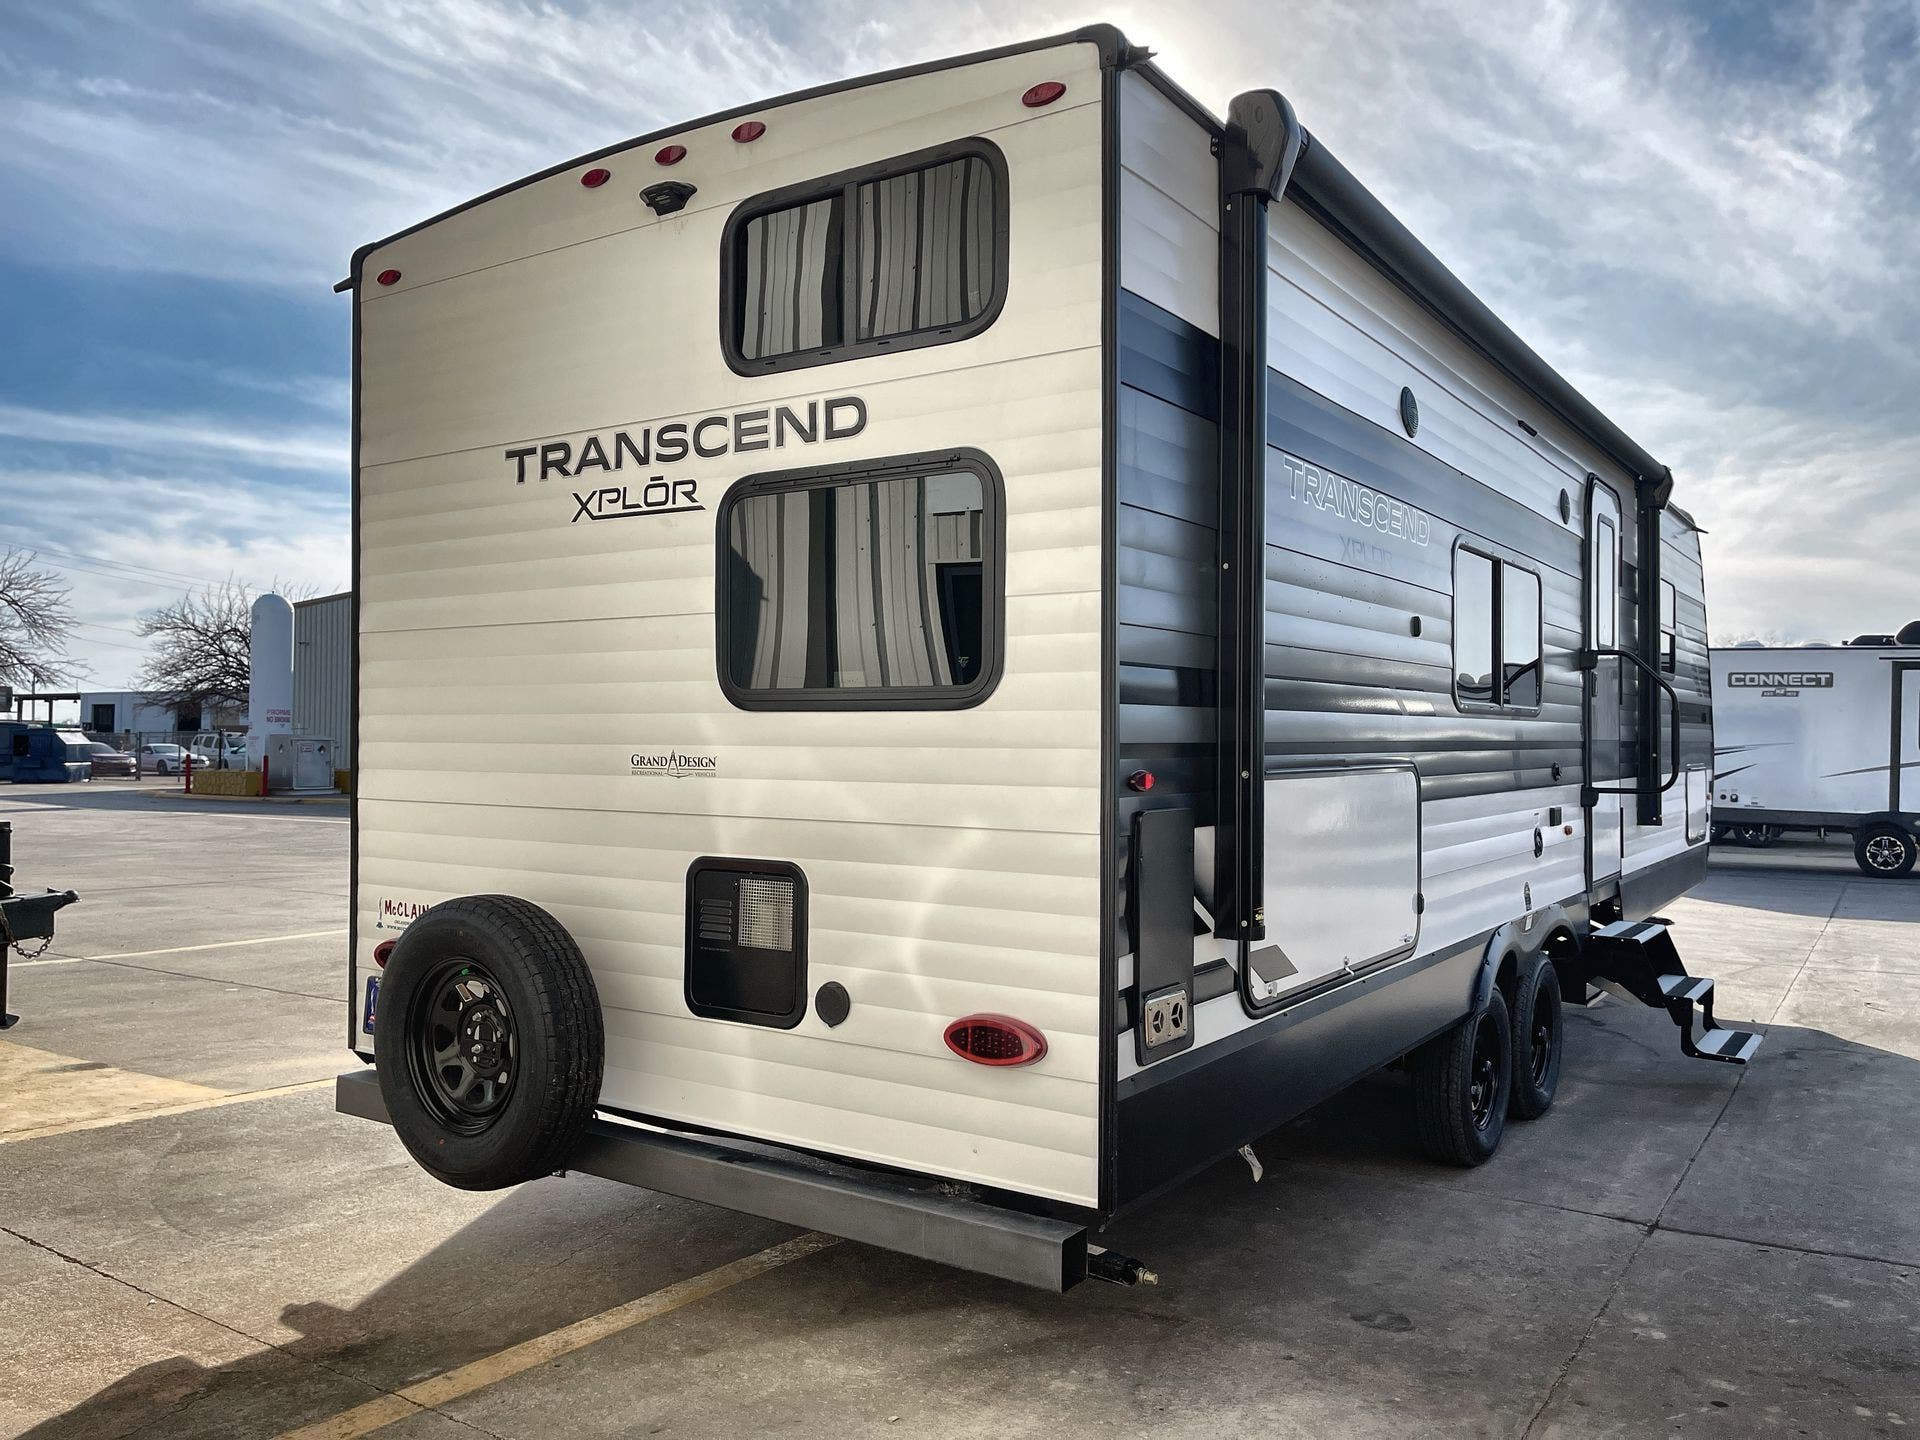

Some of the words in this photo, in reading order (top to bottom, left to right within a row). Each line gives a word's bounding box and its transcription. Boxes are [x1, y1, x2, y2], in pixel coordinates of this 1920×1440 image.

[505, 395, 869, 485] TRANSCEND
[1283, 455, 1430, 547] TRANSCEND
[1731, 674, 1830, 686] CONNECT
[631, 753, 668, 767] GRAND
[678, 754, 717, 768] DESIGN
